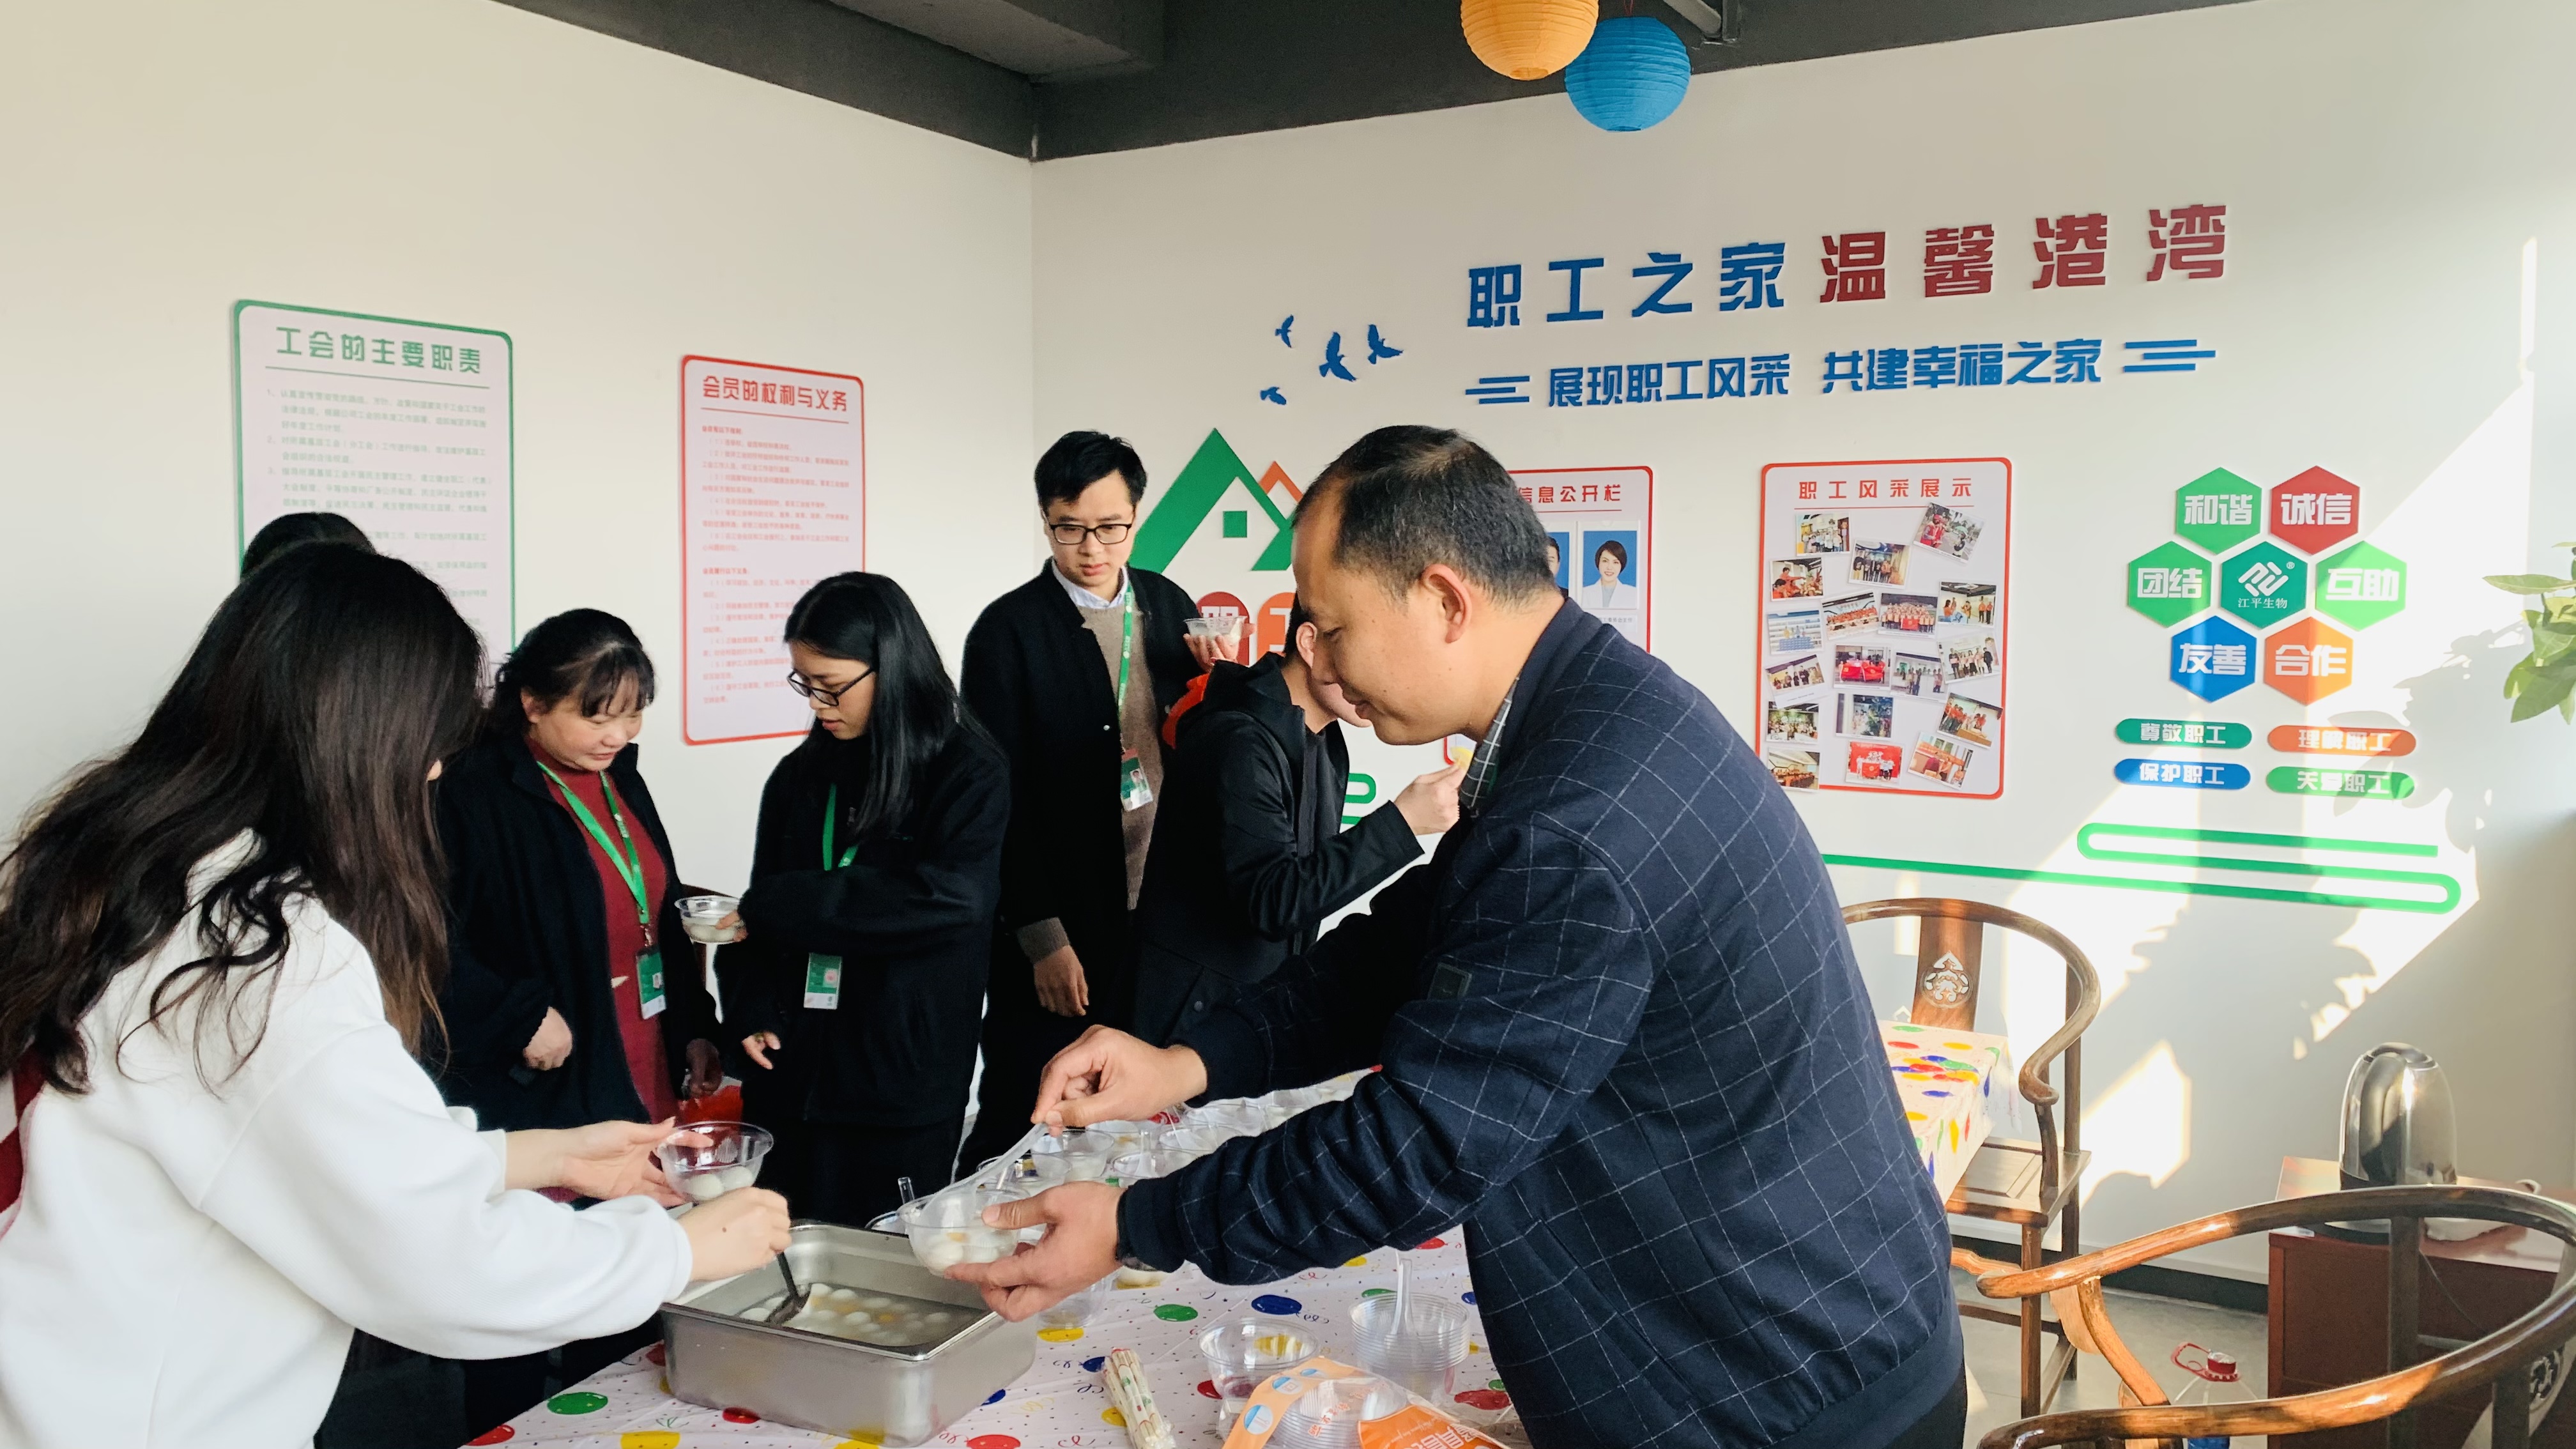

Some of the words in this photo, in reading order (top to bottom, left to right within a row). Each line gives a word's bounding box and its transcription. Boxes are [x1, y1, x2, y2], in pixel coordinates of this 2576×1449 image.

[1468, 242, 1786, 328] 职工之家
[1820, 205, 2226, 303] 温馨港湾
[276, 326, 480, 374] 工会的主要职责
[1549, 353, 1790, 408] 展现职工风采
[1823, 339, 2102, 394] 共建幸福之家
[703, 376, 847, 411] 会员的权利与义务
[1798, 477, 1972, 500] 职工风采展示
[2184, 494, 2253, 525] 和谐
[2281, 493, 2352, 525] 诚信
[2137, 567, 2202, 599] 团结
[2326, 568, 2400, 601] 互助
[2238, 597, 2288, 610] 江平生物
[2180, 643, 2246, 675] 友善
[2276, 645, 2347, 677] 合作
[2140, 723, 2227, 745] 尊敬职工
[2139, 762, 2225, 786] 保护职工
